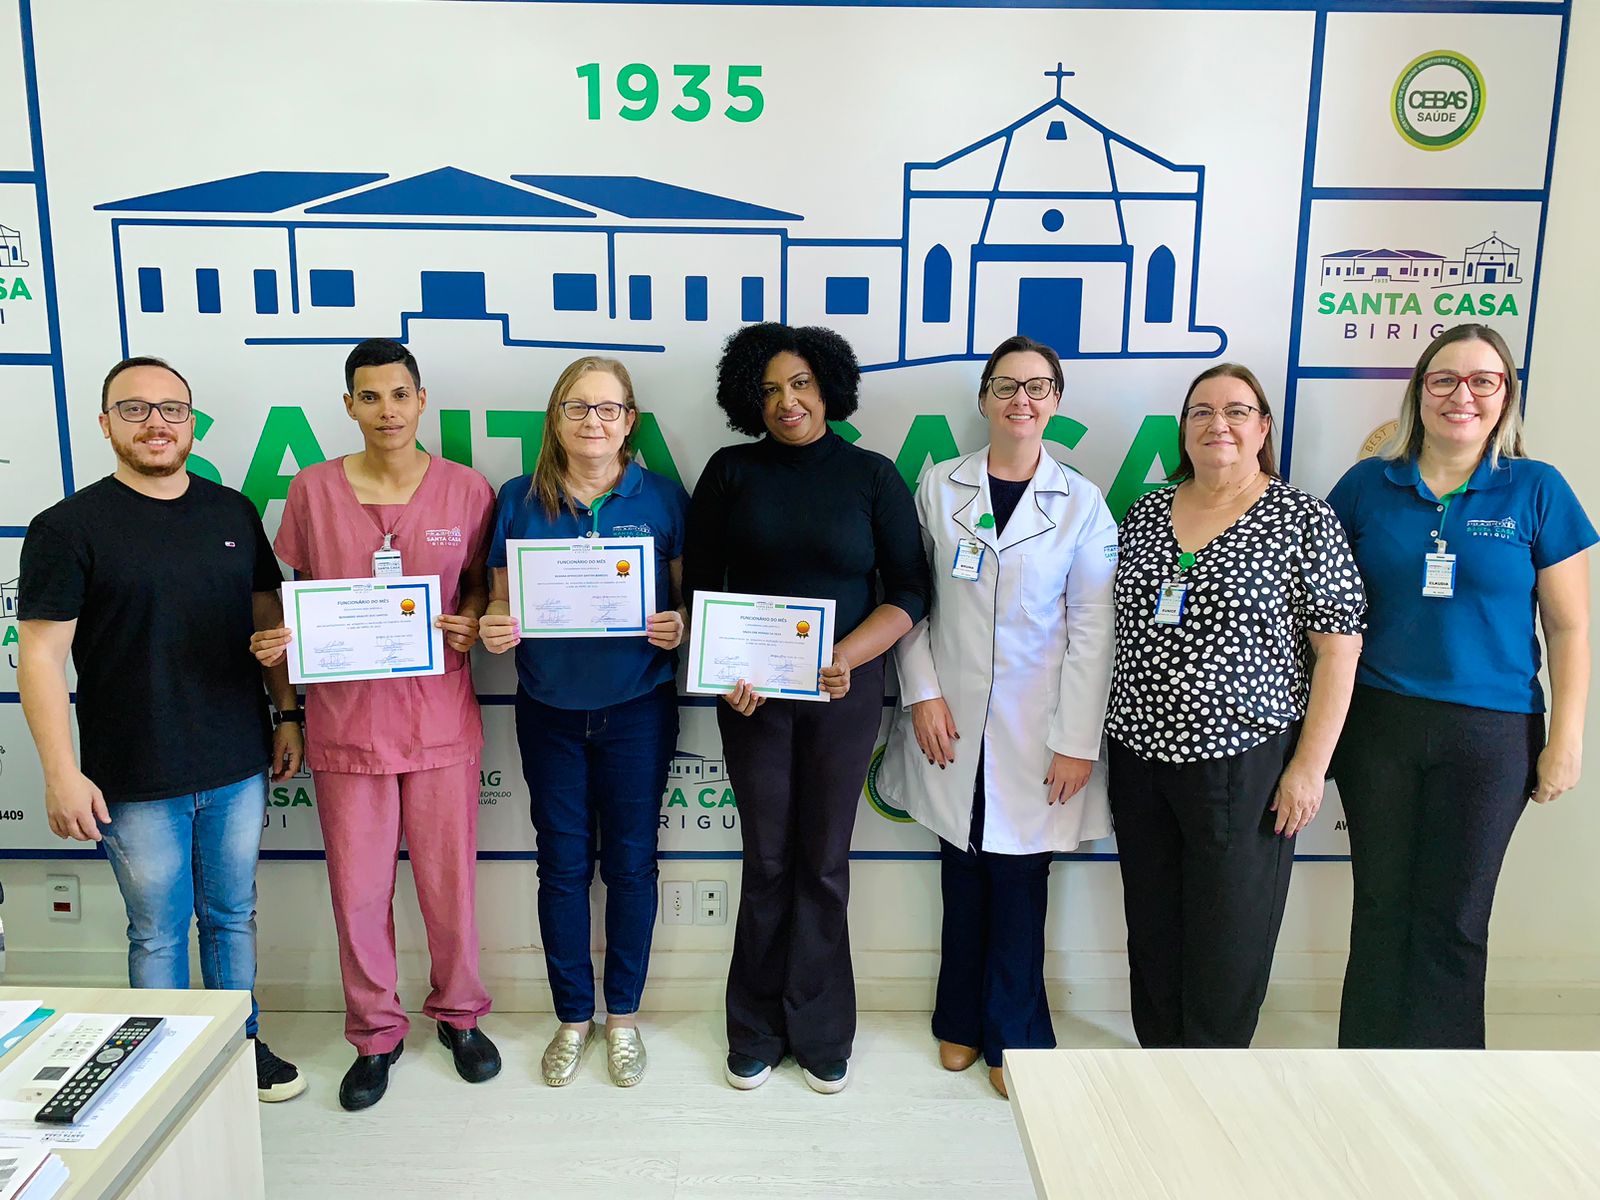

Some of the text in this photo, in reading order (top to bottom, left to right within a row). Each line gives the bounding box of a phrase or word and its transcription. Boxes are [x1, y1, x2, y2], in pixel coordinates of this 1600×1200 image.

[576, 62, 764, 123] 1935
[1409, 91, 1468, 109] CEBAS
[1417, 110, 1456, 122] SAÚDE
[1318, 291, 1519, 317] SANTA CASA
[1365, 427, 1387, 452] BEST
